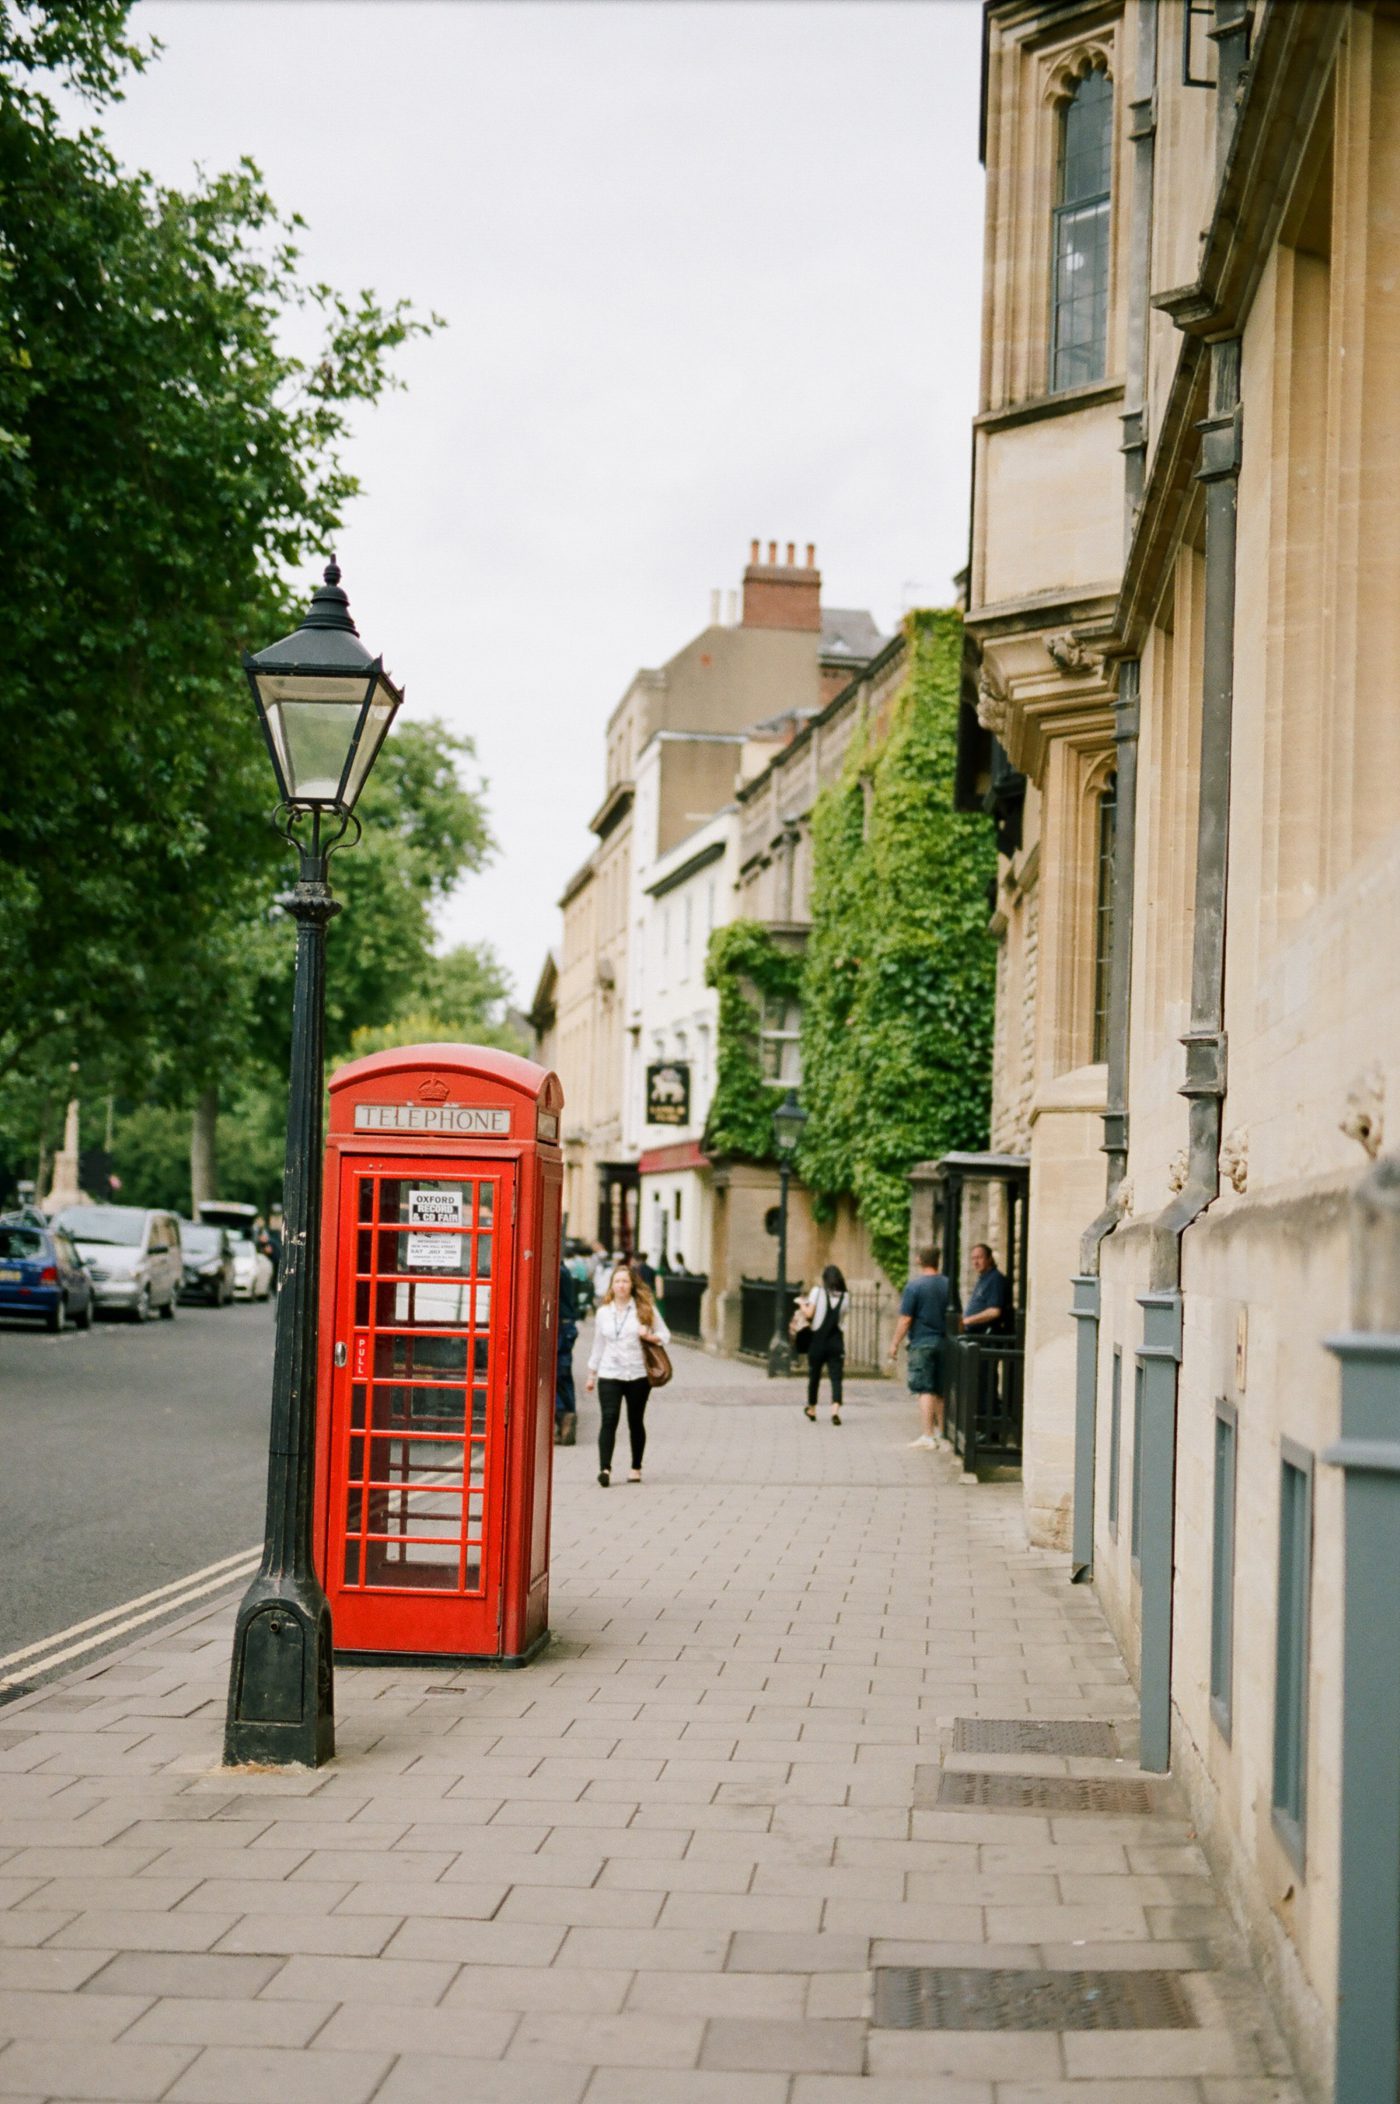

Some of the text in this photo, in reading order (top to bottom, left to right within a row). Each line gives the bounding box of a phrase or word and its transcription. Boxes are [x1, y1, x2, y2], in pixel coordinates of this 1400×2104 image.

[362, 1107, 503, 1131] TELEPHONE
[416, 1195, 455, 1204] OXFORD
[417, 1204, 453, 1214] RECORD
[412, 1212, 458, 1223] & CD FAIR
[358, 1339, 366, 1374] PULL
